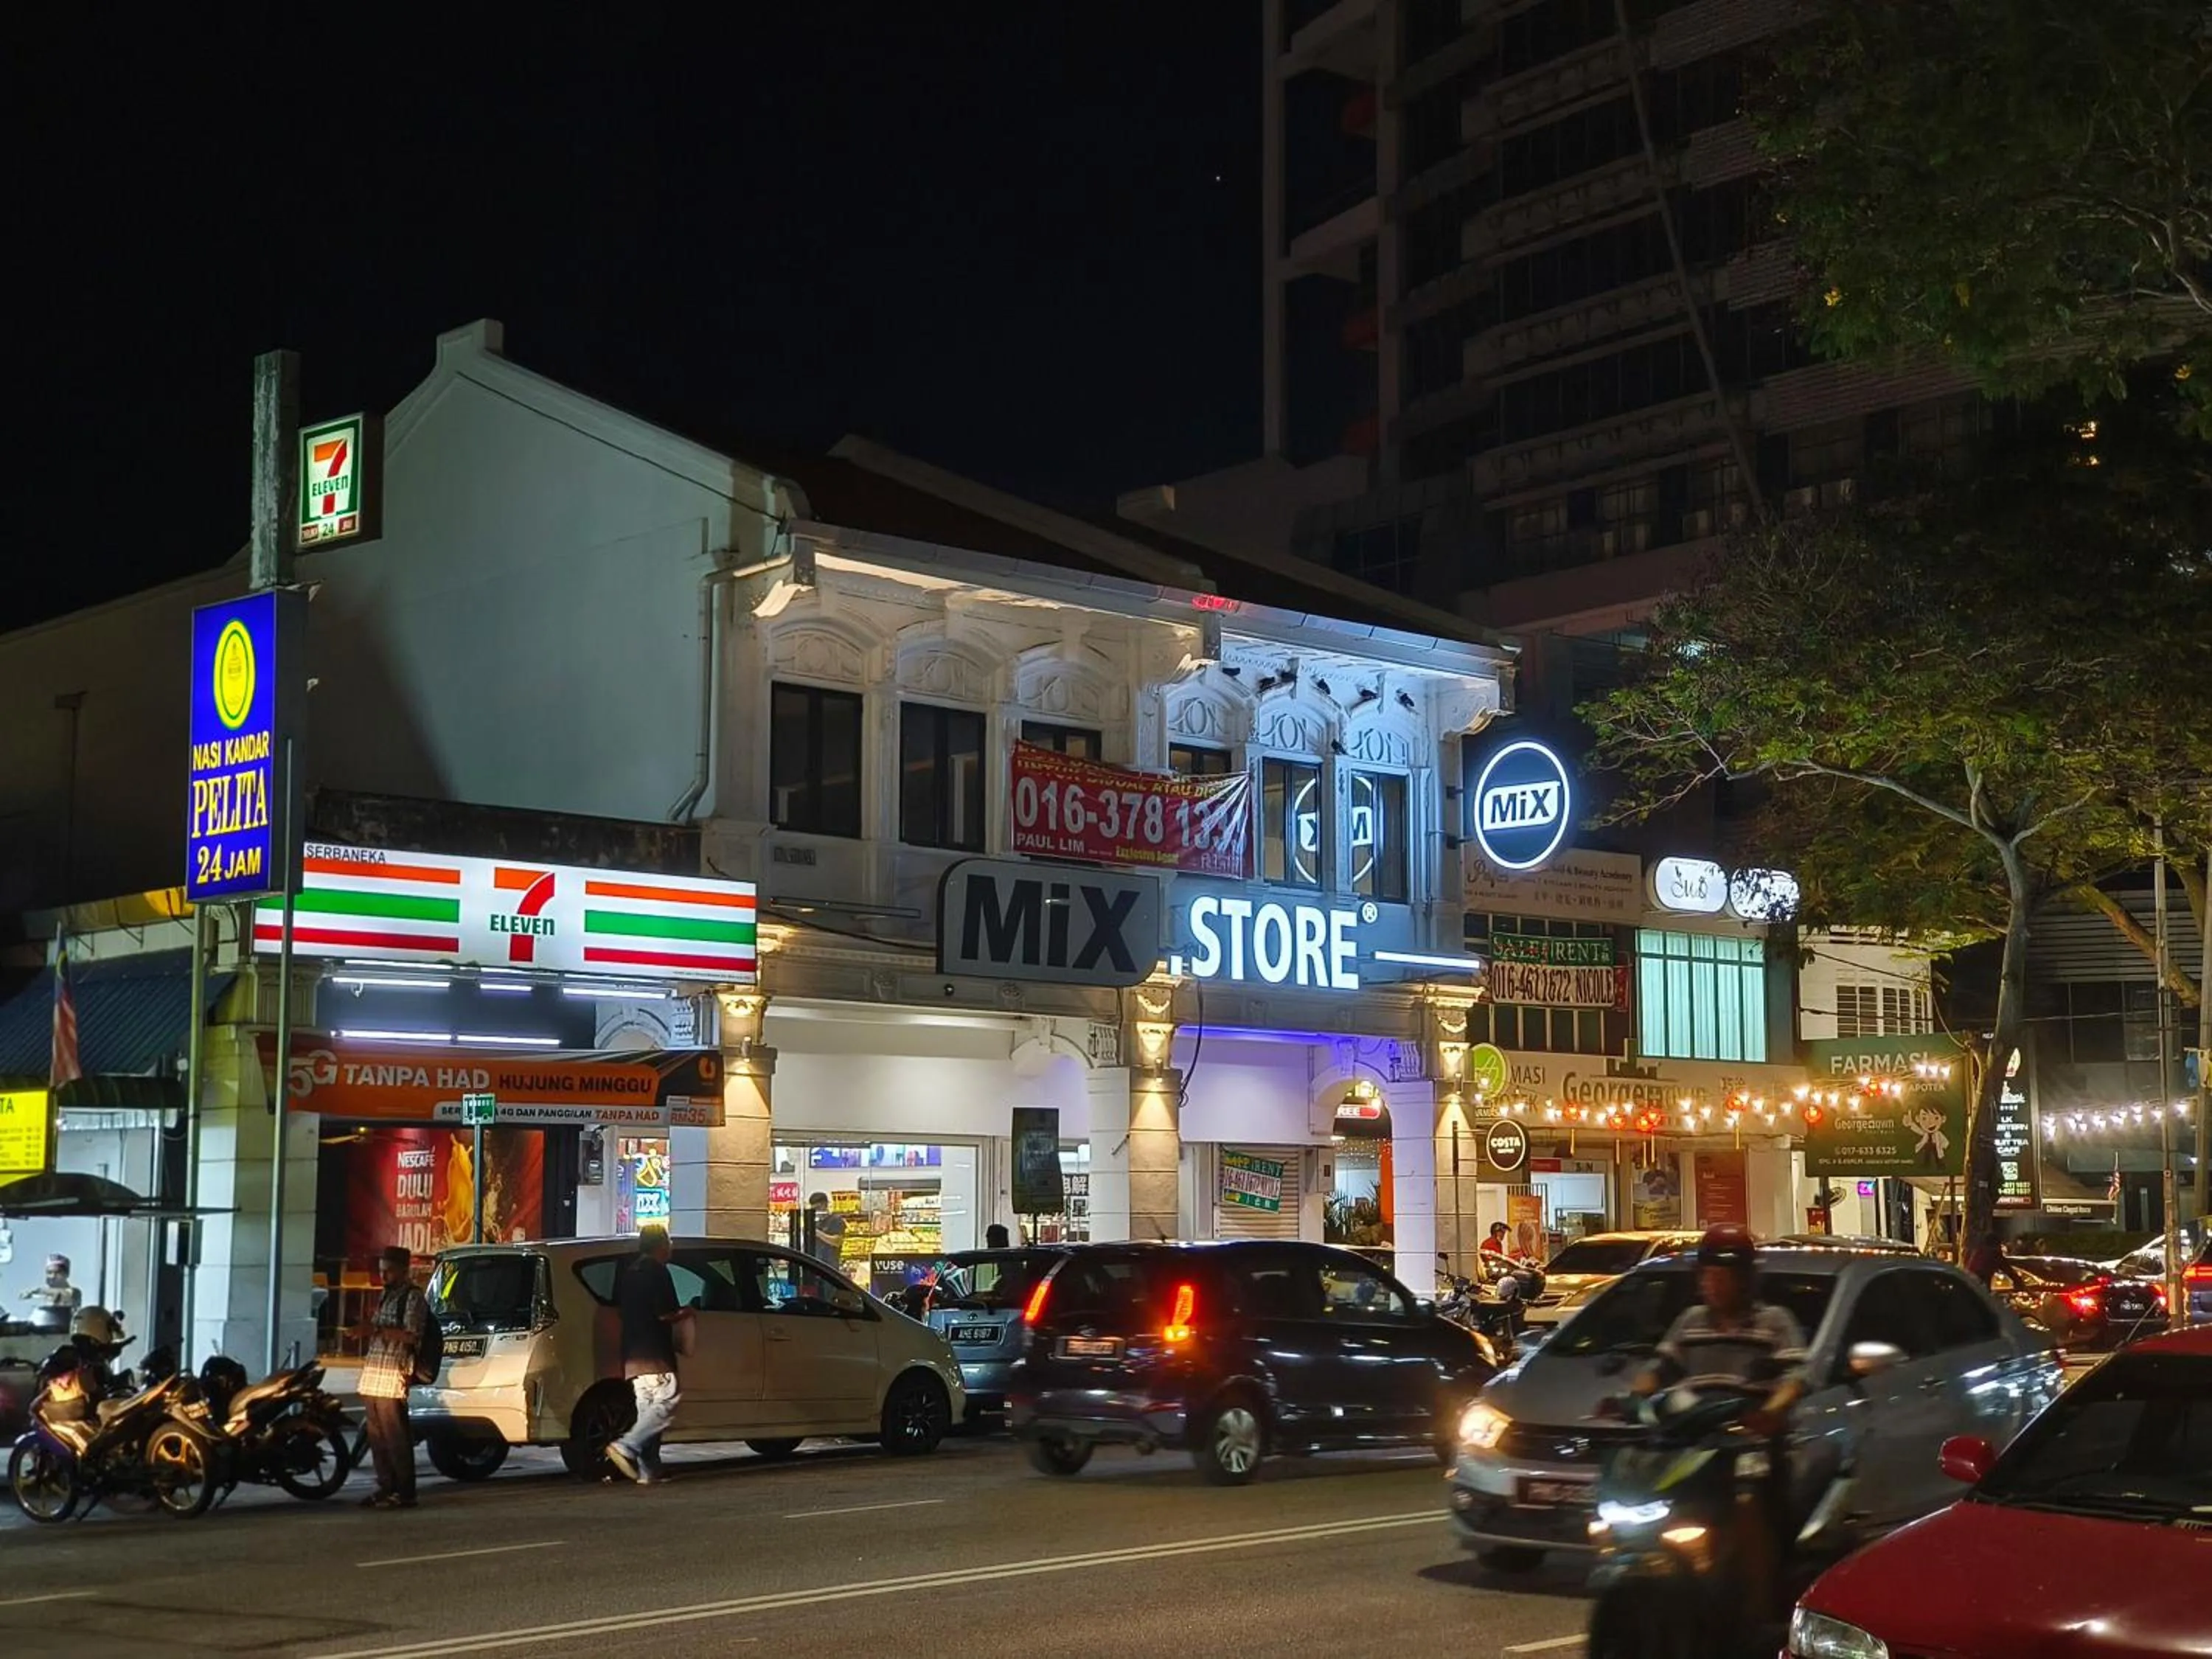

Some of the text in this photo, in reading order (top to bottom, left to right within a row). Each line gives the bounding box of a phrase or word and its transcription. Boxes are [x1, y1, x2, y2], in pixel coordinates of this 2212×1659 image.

[322, 522, 334, 537] 24
[193, 731, 270, 771] NASI KANDAR
[192, 767, 268, 838] PELITA
[1152, 781, 1191, 796] ATAU
[1015, 776, 1164, 844] 016-378
[1490, 787, 1553, 824] MiX
[305, 844, 386, 863] SERBANEKA
[1017, 832, 1054, 849] PAUL
[1059, 836, 1085, 854] LIM
[197, 844, 262, 884] 24 JAM
[960, 874, 1141, 975] MiX
[1555, 942, 1601, 961] RENT
[1576, 968, 1613, 1004] NICOLE
[288, 1048, 651, 1097] 5G TANPA HAD HUJUNG MINGGU
[1510, 1065, 1545, 1085] MASI
[516, 1107, 536, 1117] DAN
[538, 1108, 592, 1119] PANGGILAN
[595, 1110, 633, 1121] TANPA
[635, 1110, 660, 1121] HAD
[1490, 1136, 1521, 1149] COSTA
[397, 1173, 434, 1200] DULU
[397, 1222, 432, 1254] JADI
